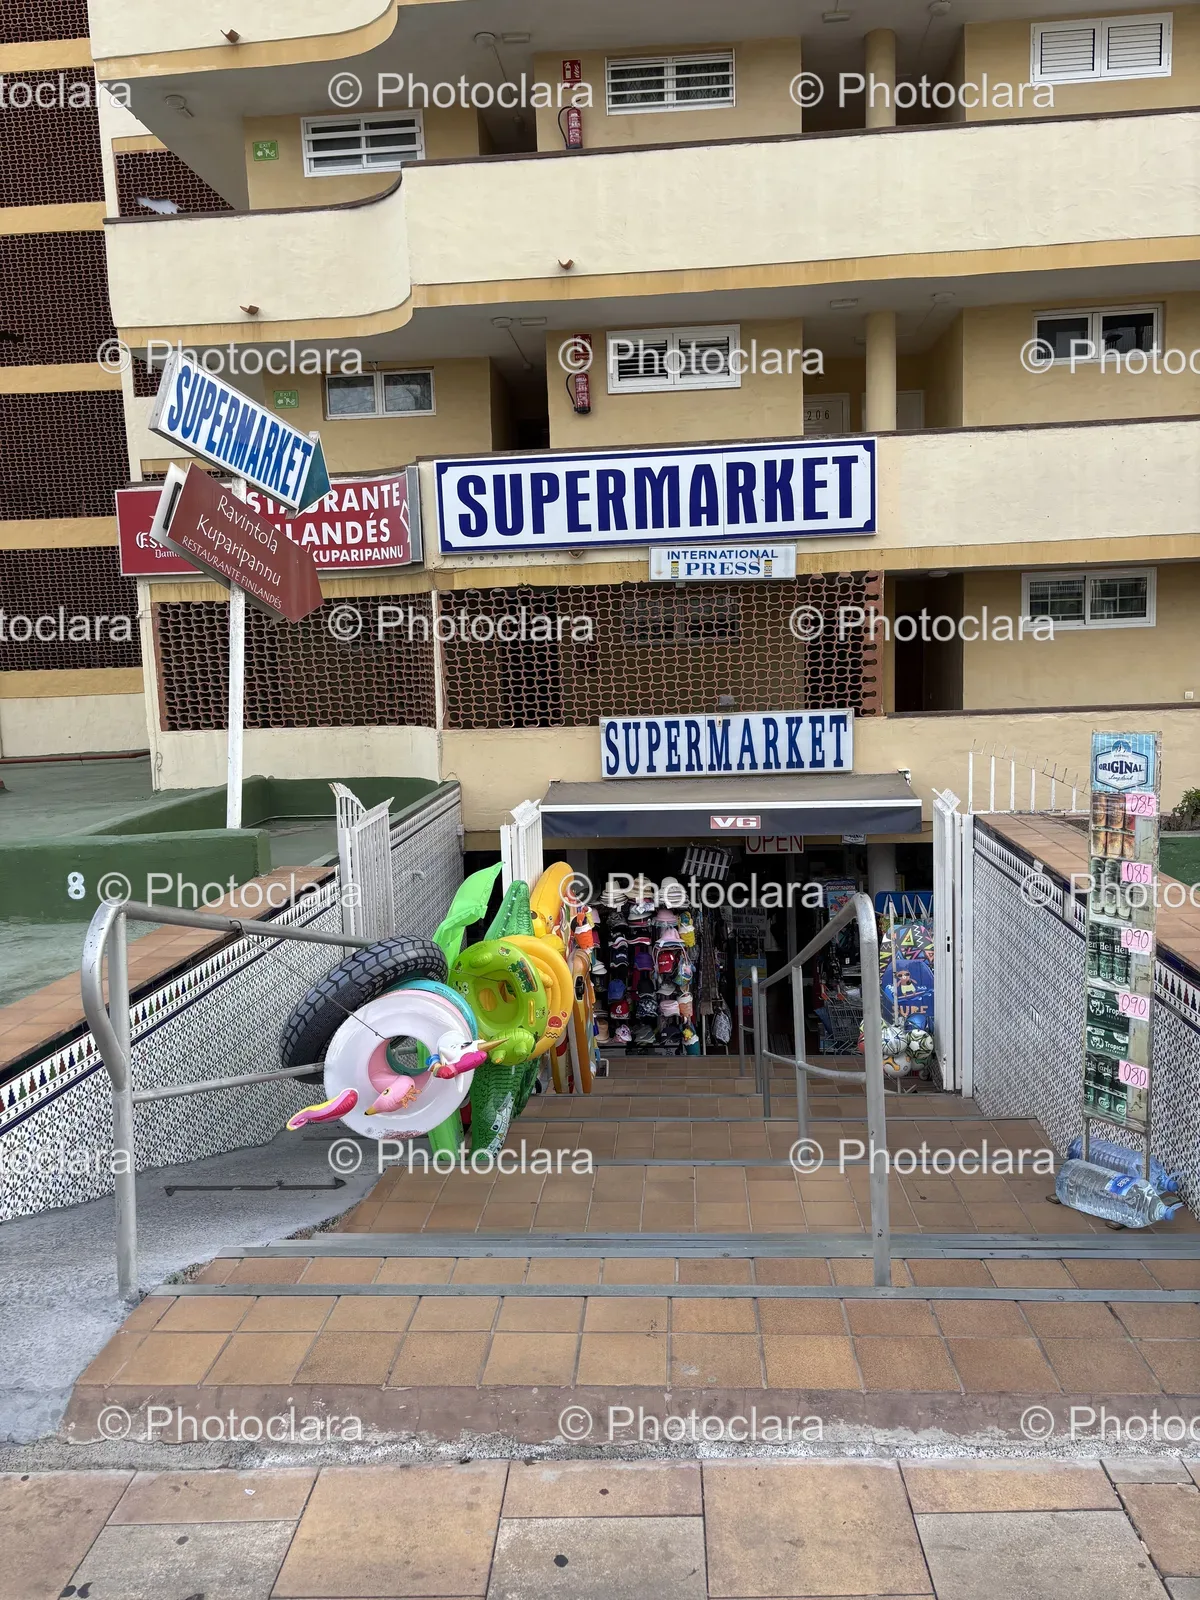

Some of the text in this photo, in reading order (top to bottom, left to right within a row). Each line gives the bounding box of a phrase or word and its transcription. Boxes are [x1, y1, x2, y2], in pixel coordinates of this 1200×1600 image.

[807, 410, 830, 420] 206
[167, 365, 313, 501] SUPERMARKET
[456, 455, 858, 537] SUPERMARKET
[217, 494, 279, 555] Ravintola
[196, 513, 281, 586] Kuparipannu
[667, 549, 778, 560] INTERNATIONAL
[182, 535, 283, 609] RESTAURANTE FINLANDÉS
[685, 562, 761, 576] PRESS
[605, 715, 847, 776] SUPERMARKET
[1099, 760, 1144, 774] ORIGINAL
[1130, 794, 1154, 817] 085
[713, 817, 757, 828] VG
[747, 835, 803, 852] OPEN
[1126, 862, 1149, 884] 085
[67, 871, 86, 899] 8
[1121, 994, 1147, 1015] 090
[1104, 1040, 1126, 1052] Tropical
[1123, 1063, 1147, 1086] 080
